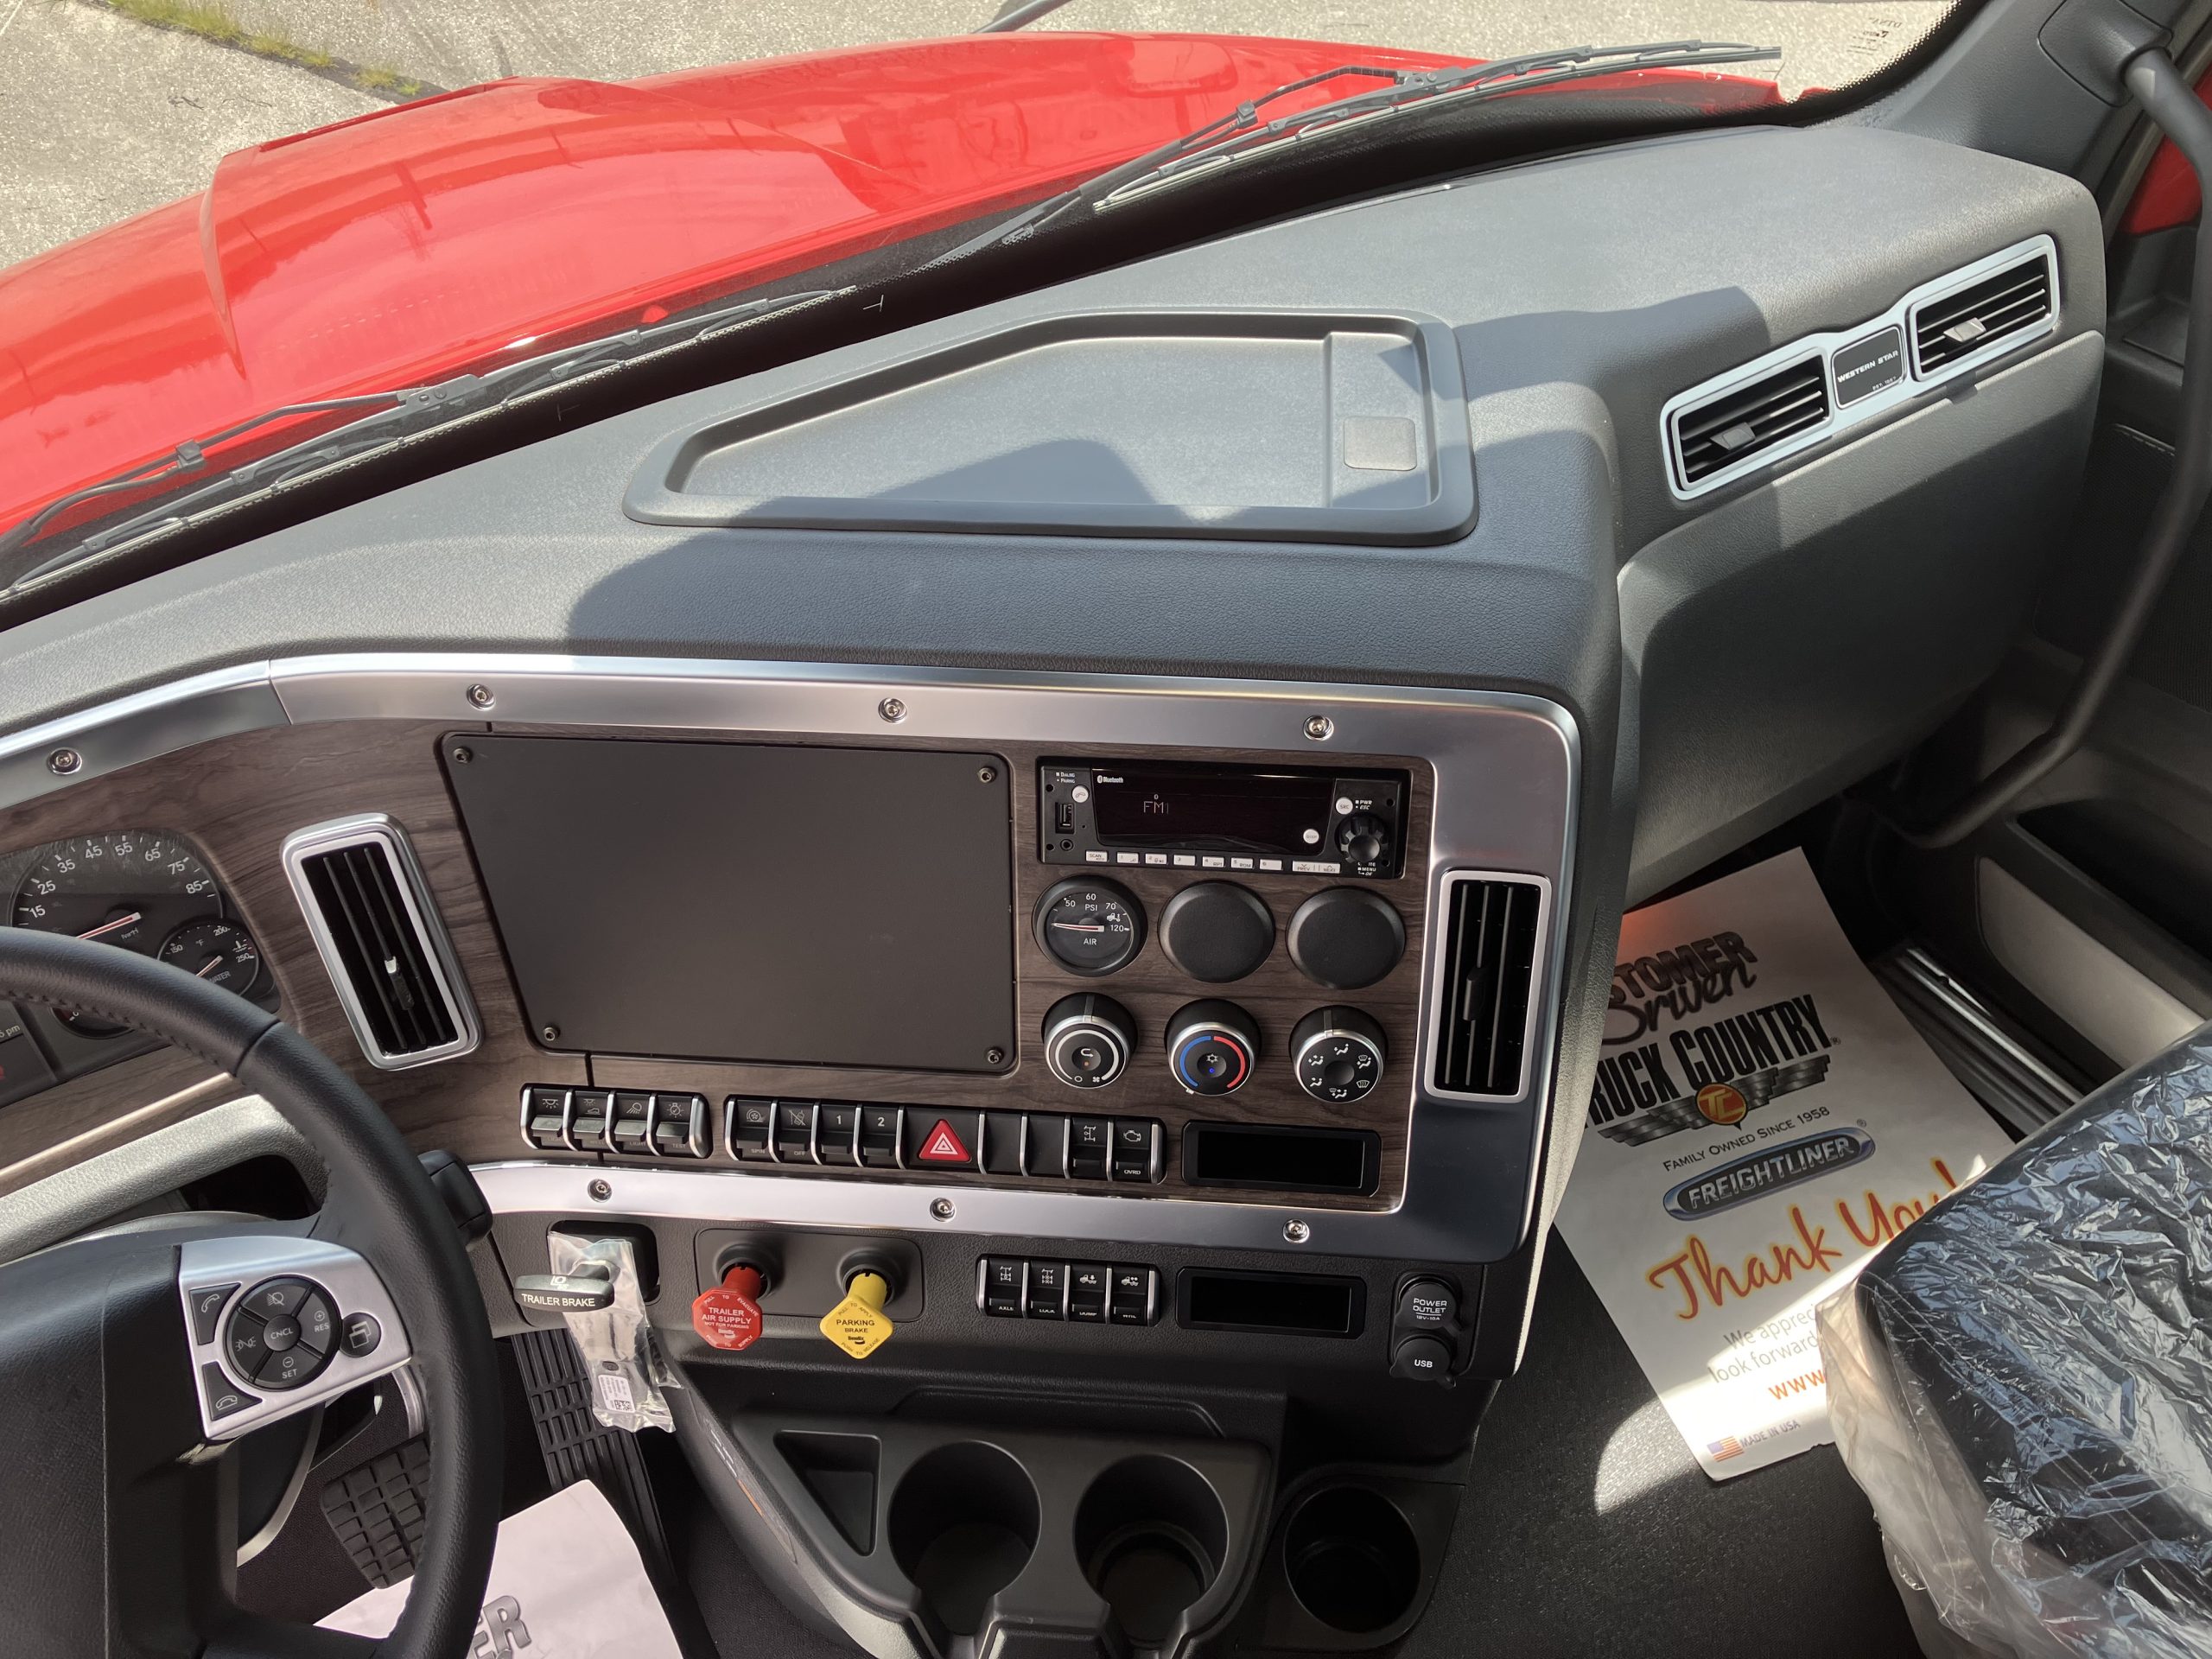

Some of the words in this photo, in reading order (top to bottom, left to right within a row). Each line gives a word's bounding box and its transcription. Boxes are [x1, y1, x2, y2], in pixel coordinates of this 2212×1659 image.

[1837, 360, 1876, 383] WESTERN
[1878, 350, 1899, 365] STAR
[85, 845, 103, 859] 45
[114, 842, 133, 856] 55
[144, 849, 161, 861] 65
[57, 859, 76, 874] 35
[168, 860, 186, 875] 75
[37, 880, 56, 895] 25
[185, 880, 203, 894] 85
[1085, 893, 1096, 901] 60
[29, 905, 46, 918] 15
[213, 926, 228, 937] 200
[1083, 938, 1097, 946] AIR
[170, 944, 183, 953] 150
[236, 953, 250, 963] 250
[6, 1025, 21, 1037] pm
[1583, 1043, 1681, 1128] RUCK
[1669, 995, 1832, 1090] COUNTRY
[836, 1115, 842, 1124] 1
[877, 1117, 885, 1127] 2
[1662, 1150, 1706, 1172] FAMILY
[1709, 1133, 1757, 1155] OWNED
[1757, 1119, 1796, 1139] SINCE
[1796, 1106, 1830, 1124] 1958
[1688, 1137, 1854, 1210] FREIGHTLINER
[1649, 1207, 1842, 1319] Thank
[521, 1294, 560, 1306] TRAILER
[562, 1298, 595, 1306] BRAKE
[1413, 1298, 1447, 1306] POWER
[709, 1306, 744, 1317] TRAILER
[737, 1297, 760, 1317] EVACUATE
[1413, 1305, 1446, 1313] OUTLET
[702, 1313, 716, 1322] AIR
[718, 1316, 752, 1325] SUPPLY
[314, 1322, 330, 1332] RES
[1723, 1329, 1757, 1350] We
[1756, 1303, 1816, 1341] apprec
[270, 1326, 294, 1340] CNCL
[1414, 1358, 1433, 1368] USB
[1707, 1357, 1752, 1383] look
[1750, 1331, 1820, 1369] forward
[281, 1370, 297, 1380] SET
[1739, 1430, 1769, 1448] MADE
[1769, 1426, 1780, 1438] IN
[1781, 1419, 1801, 1433] USA
